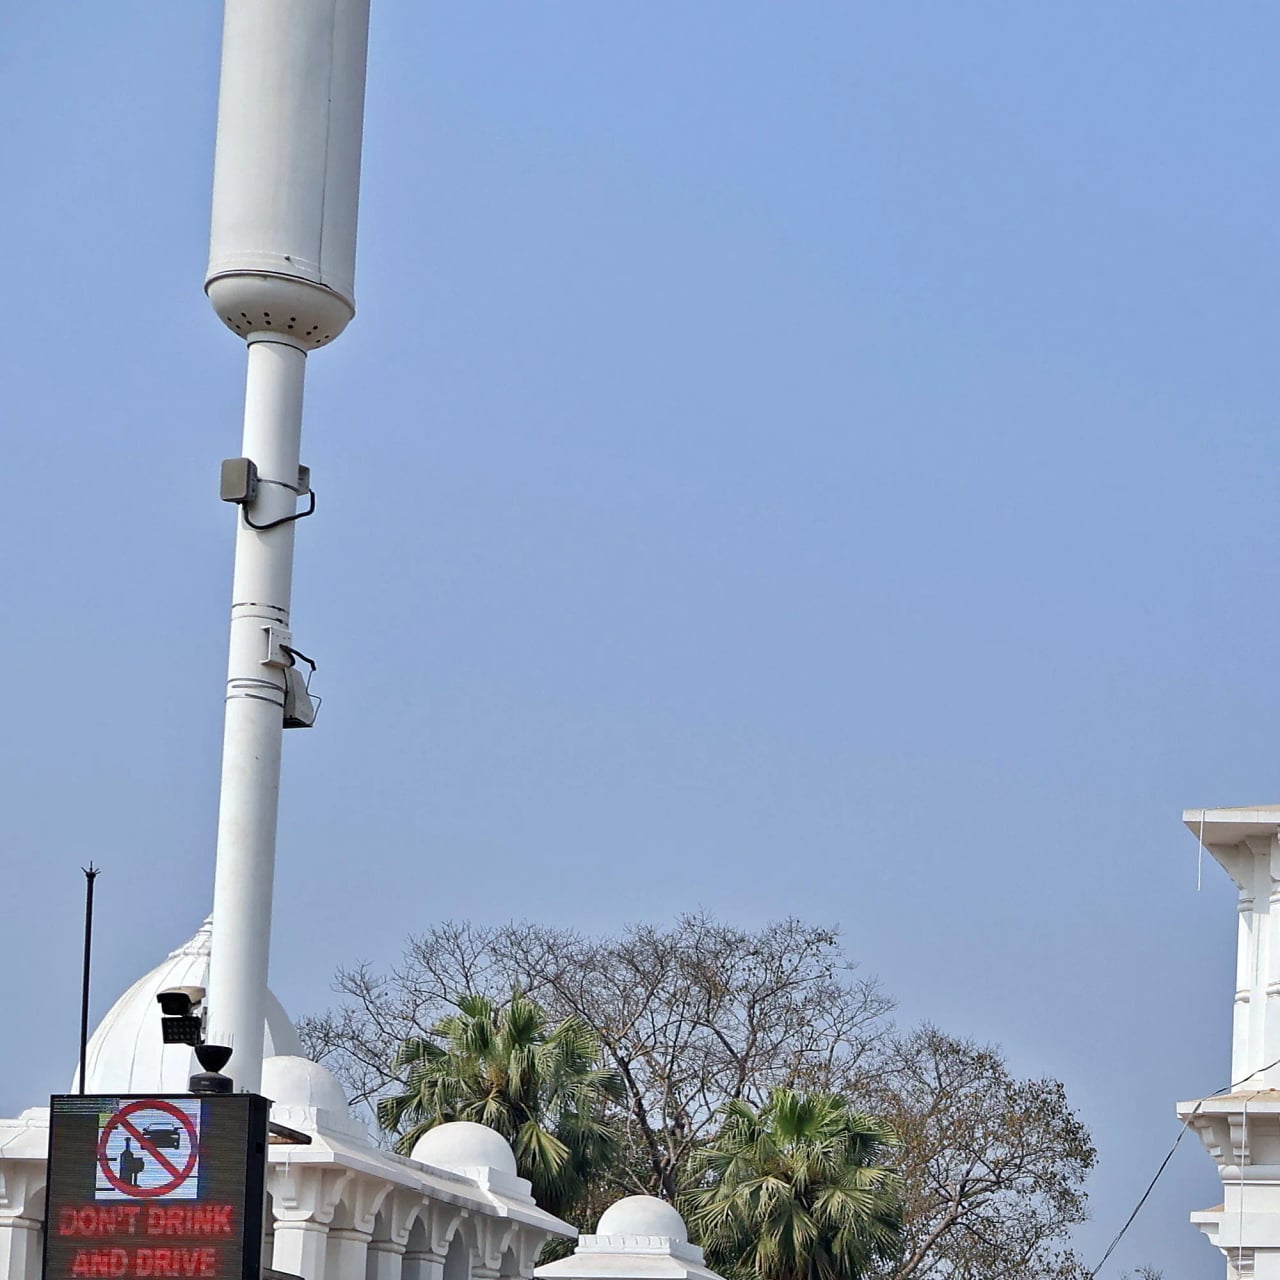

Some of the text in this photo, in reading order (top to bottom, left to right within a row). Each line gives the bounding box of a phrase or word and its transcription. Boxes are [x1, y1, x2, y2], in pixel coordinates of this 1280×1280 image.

[59, 1204, 233, 1236] DON'T DRINK
[71, 1247, 216, 1278] AND DRIVE
